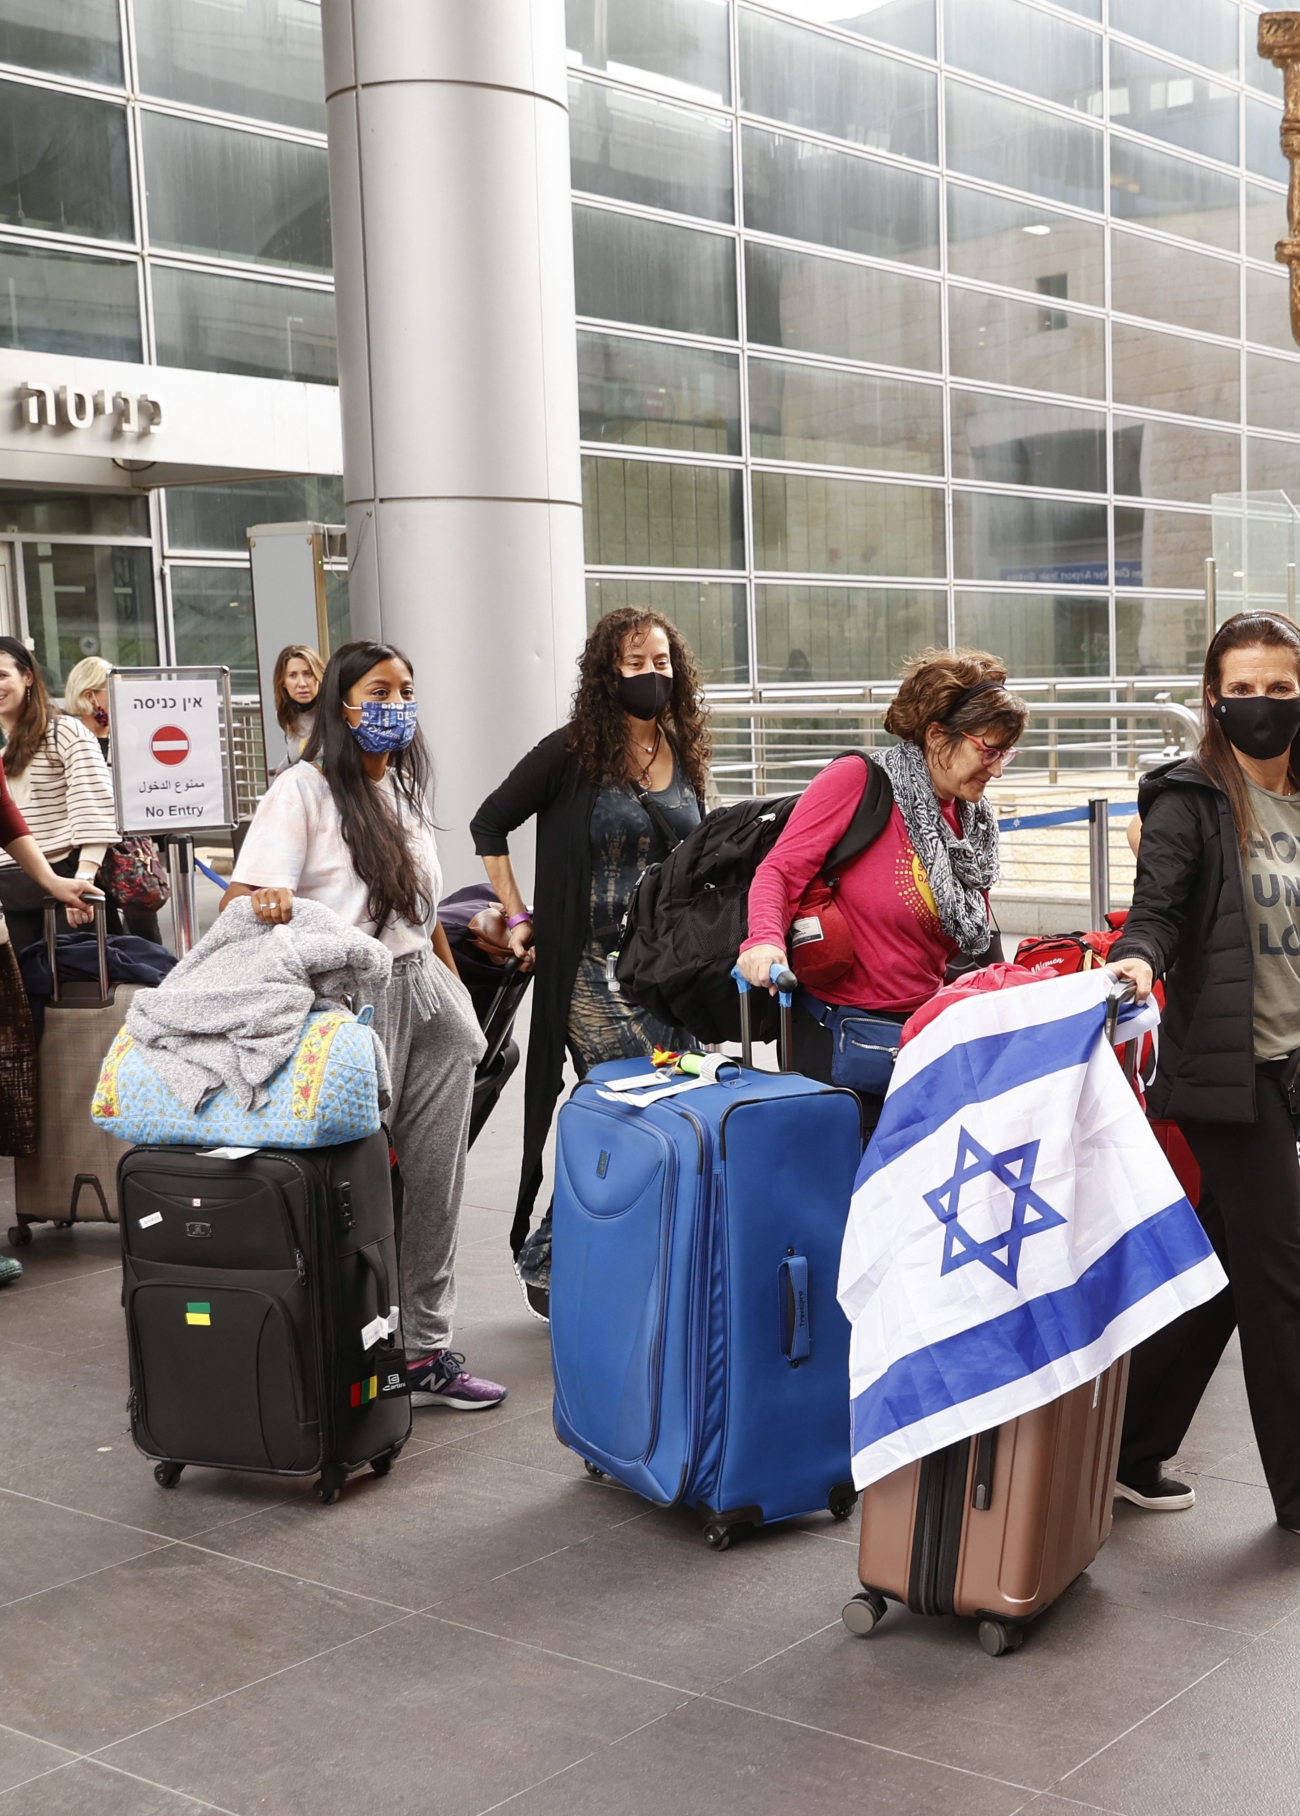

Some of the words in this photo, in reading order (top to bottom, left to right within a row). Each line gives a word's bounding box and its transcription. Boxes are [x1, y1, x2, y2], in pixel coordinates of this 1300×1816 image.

[133, 698, 177, 709] כניסה
[182, 697, 203, 711] אין
[138, 780, 172, 794] الدخول
[175, 779, 205, 794] ممنوع
[145, 807, 164, 817] No
[169, 805, 204, 818] Entry
